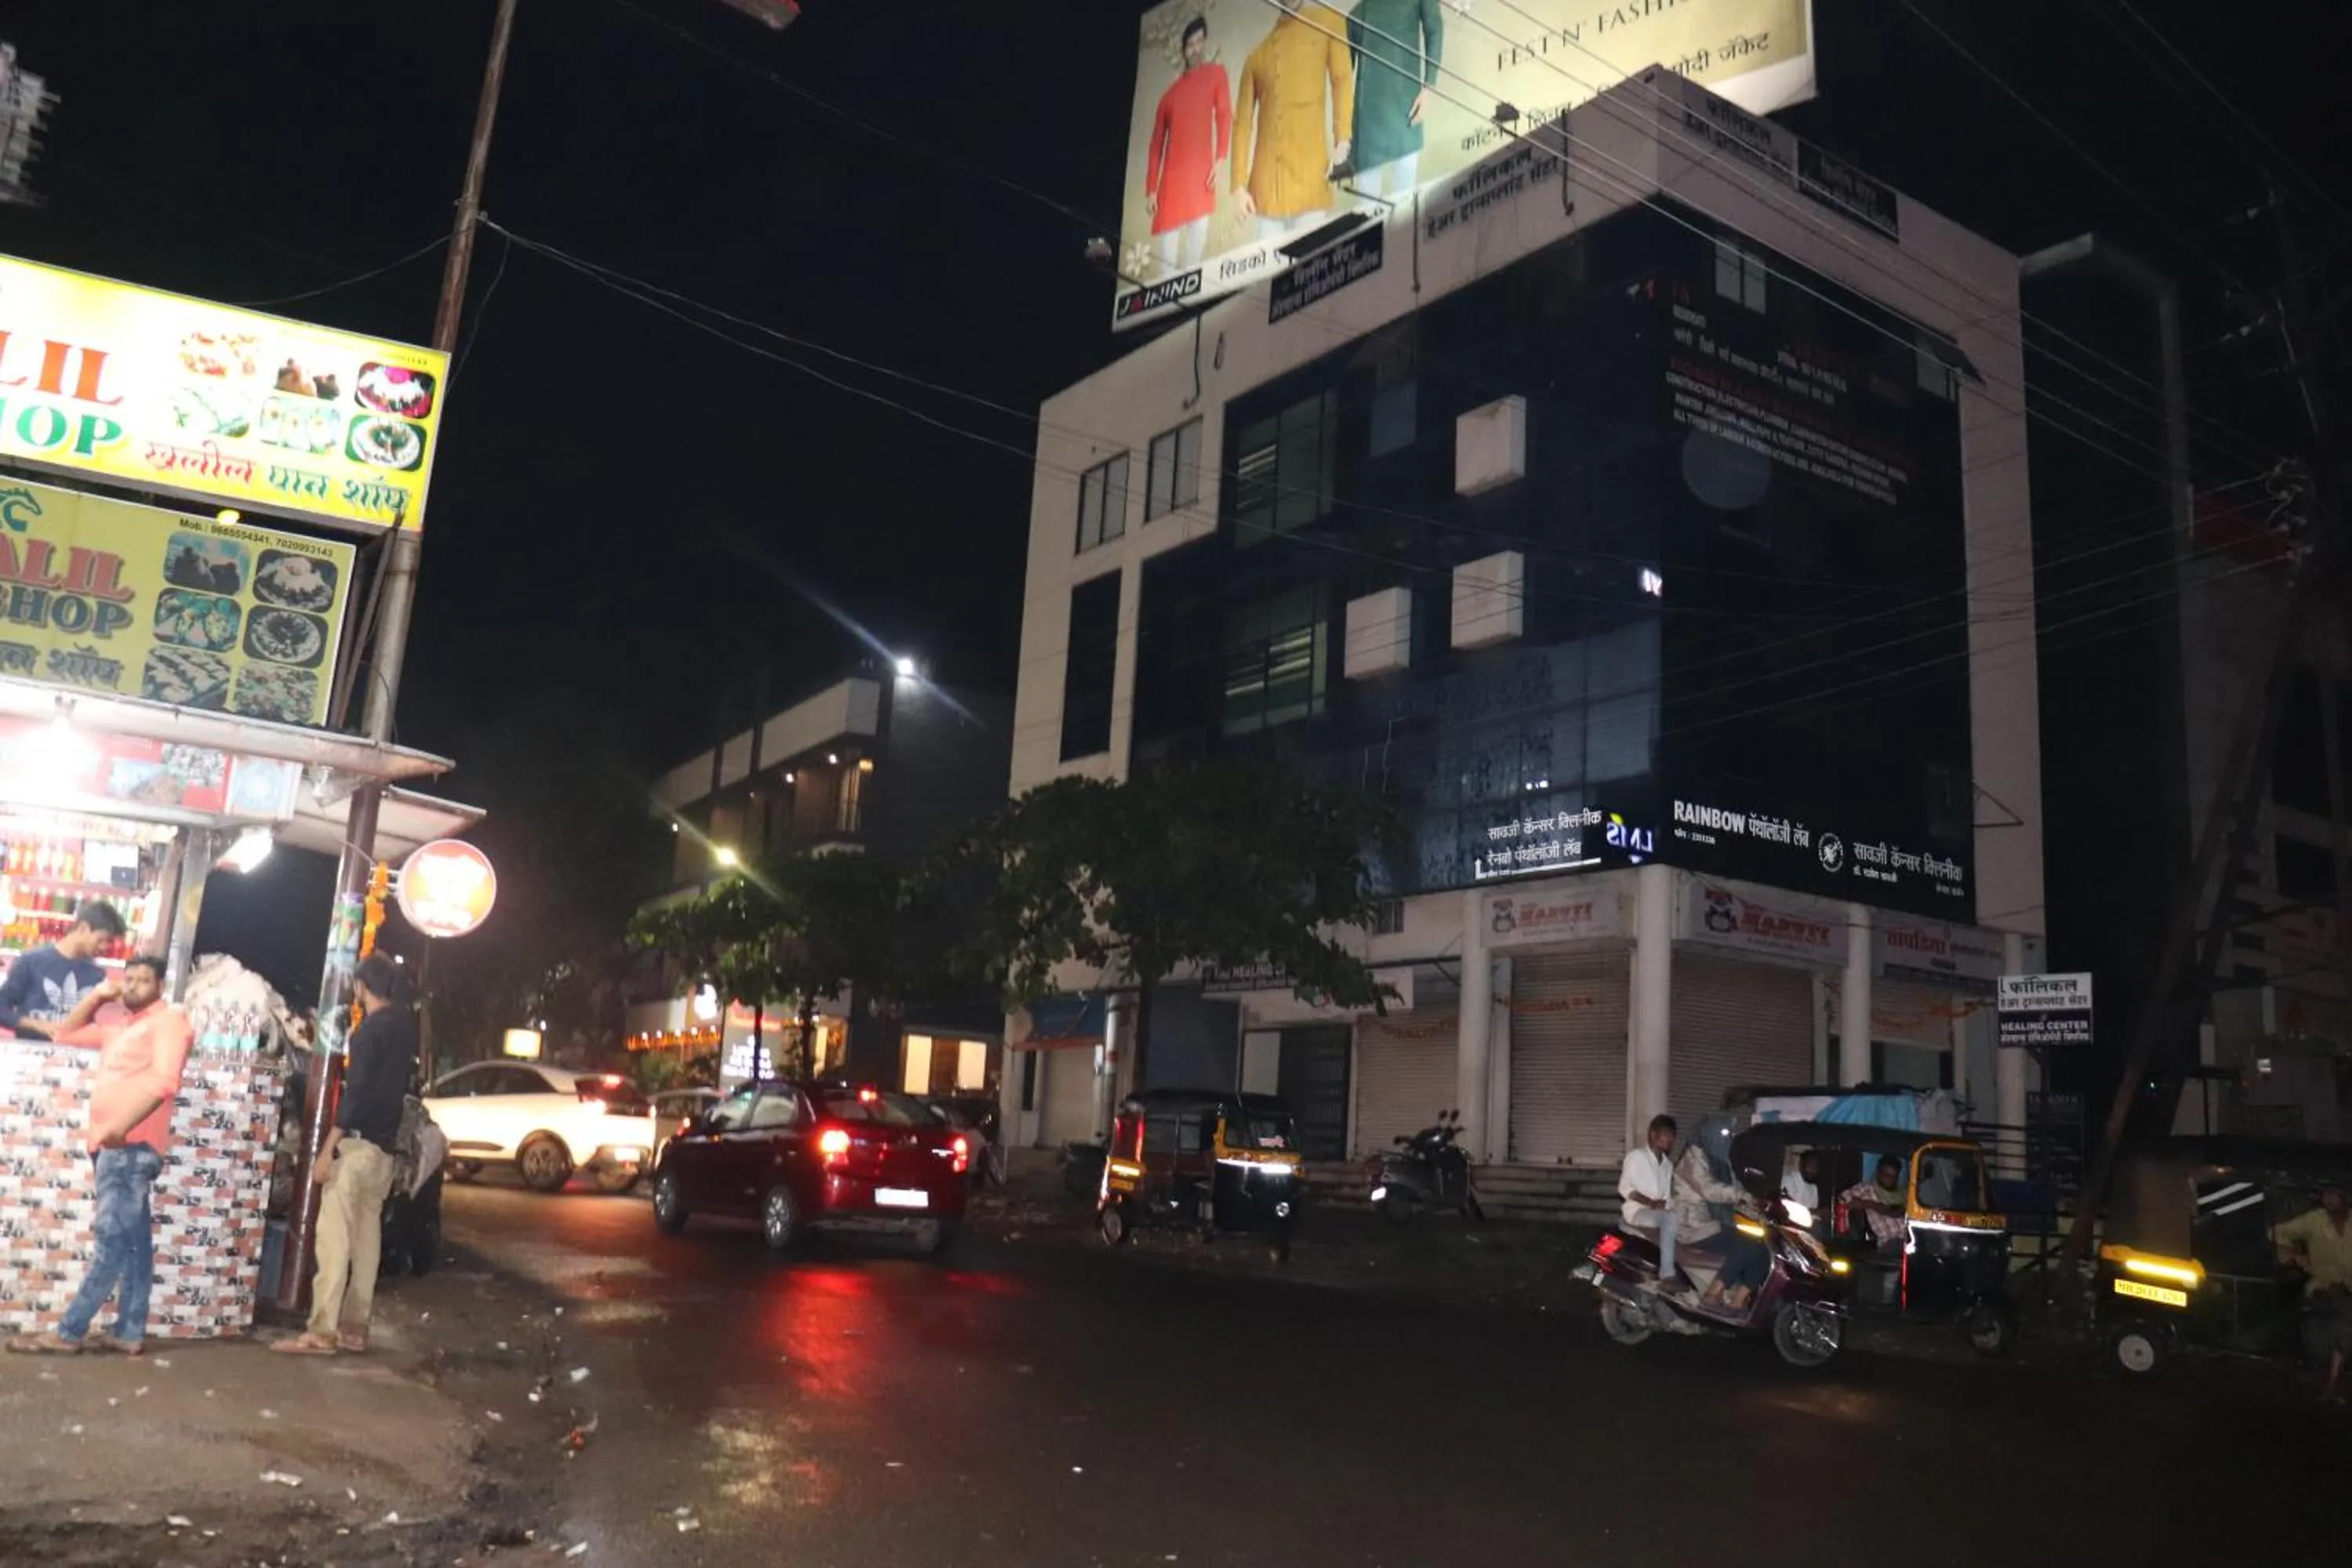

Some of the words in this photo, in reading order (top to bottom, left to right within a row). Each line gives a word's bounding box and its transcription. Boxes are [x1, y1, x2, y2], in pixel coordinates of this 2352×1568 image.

[1674, 800, 1745, 834] RAINBOW
[1853, 841, 1887, 865] सावजी
[2000, 1021, 2044, 1032] HEALING
[2046, 1019, 2088, 1030] CENTER
